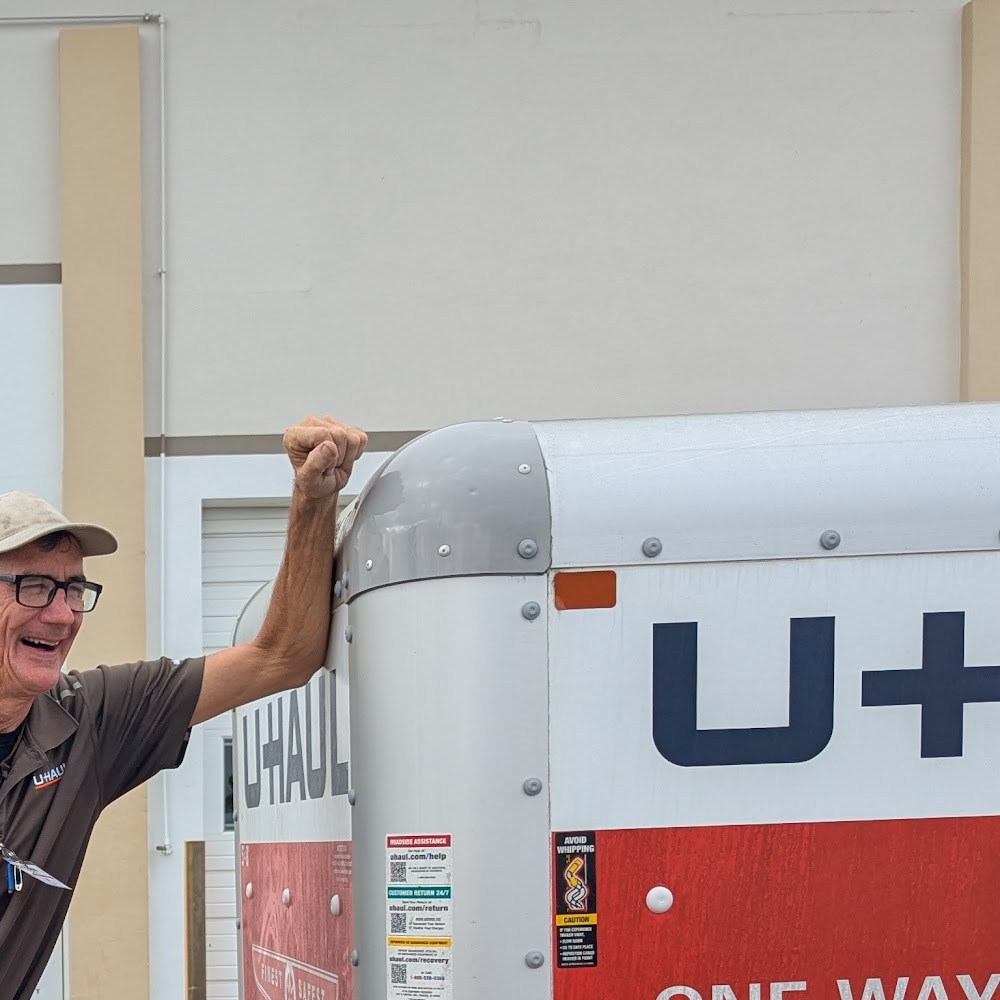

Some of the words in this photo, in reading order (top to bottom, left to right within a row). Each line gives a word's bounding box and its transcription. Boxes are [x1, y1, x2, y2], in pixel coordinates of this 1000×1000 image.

[243, 669, 349, 808] U-HAUL
[414, 837, 447, 845] ASSISTANCE
[564, 836, 587, 844] AVOID
[556, 844, 595, 854] WHIPPING
[390, 852, 447, 861] uhaul.com/help
[389, 904, 449, 912] uhaul.com/return
[563, 916, 590, 924] CAUTION
[390, 956, 449, 965] uhaul.com/recovery
[261, 963, 282, 989] FINEST
